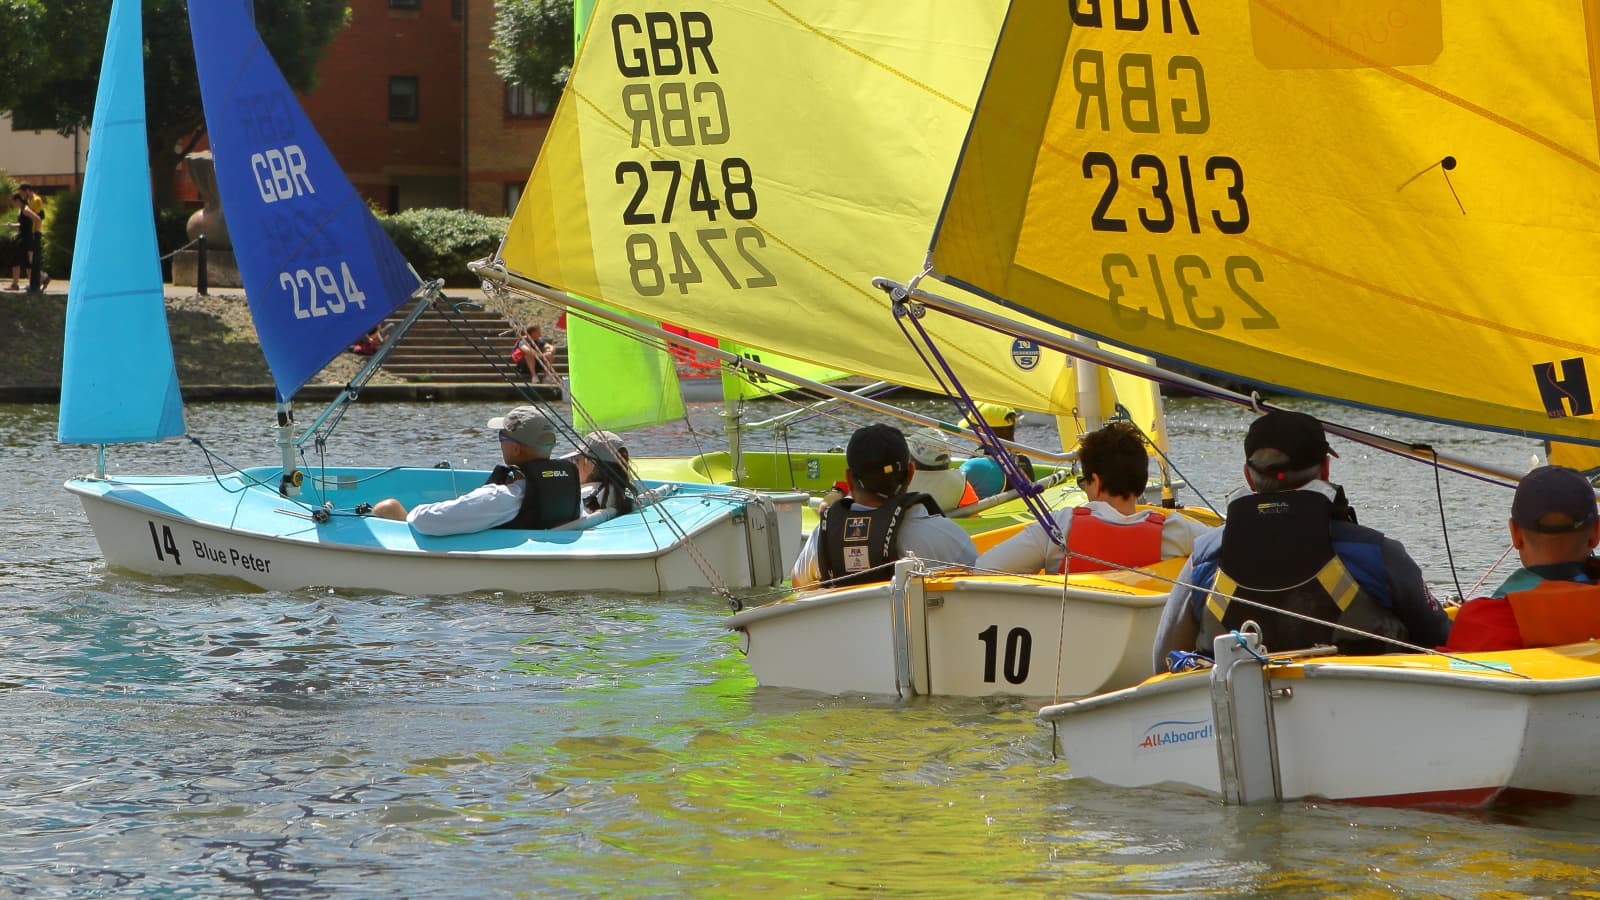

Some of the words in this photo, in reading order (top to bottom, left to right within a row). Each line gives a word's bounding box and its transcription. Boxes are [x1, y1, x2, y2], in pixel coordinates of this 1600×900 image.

[612, 12, 718, 78] GBR
[252, 145, 314, 203] GBR
[616, 158, 757, 225] 2748
[1082, 152, 1249, 234] 2313
[280, 262, 366, 319] 2294
[148, 520, 182, 566] 14
[192, 540, 228, 564] Blue
[229, 548, 271, 574] Peter
[978, 625, 1033, 685] 10
